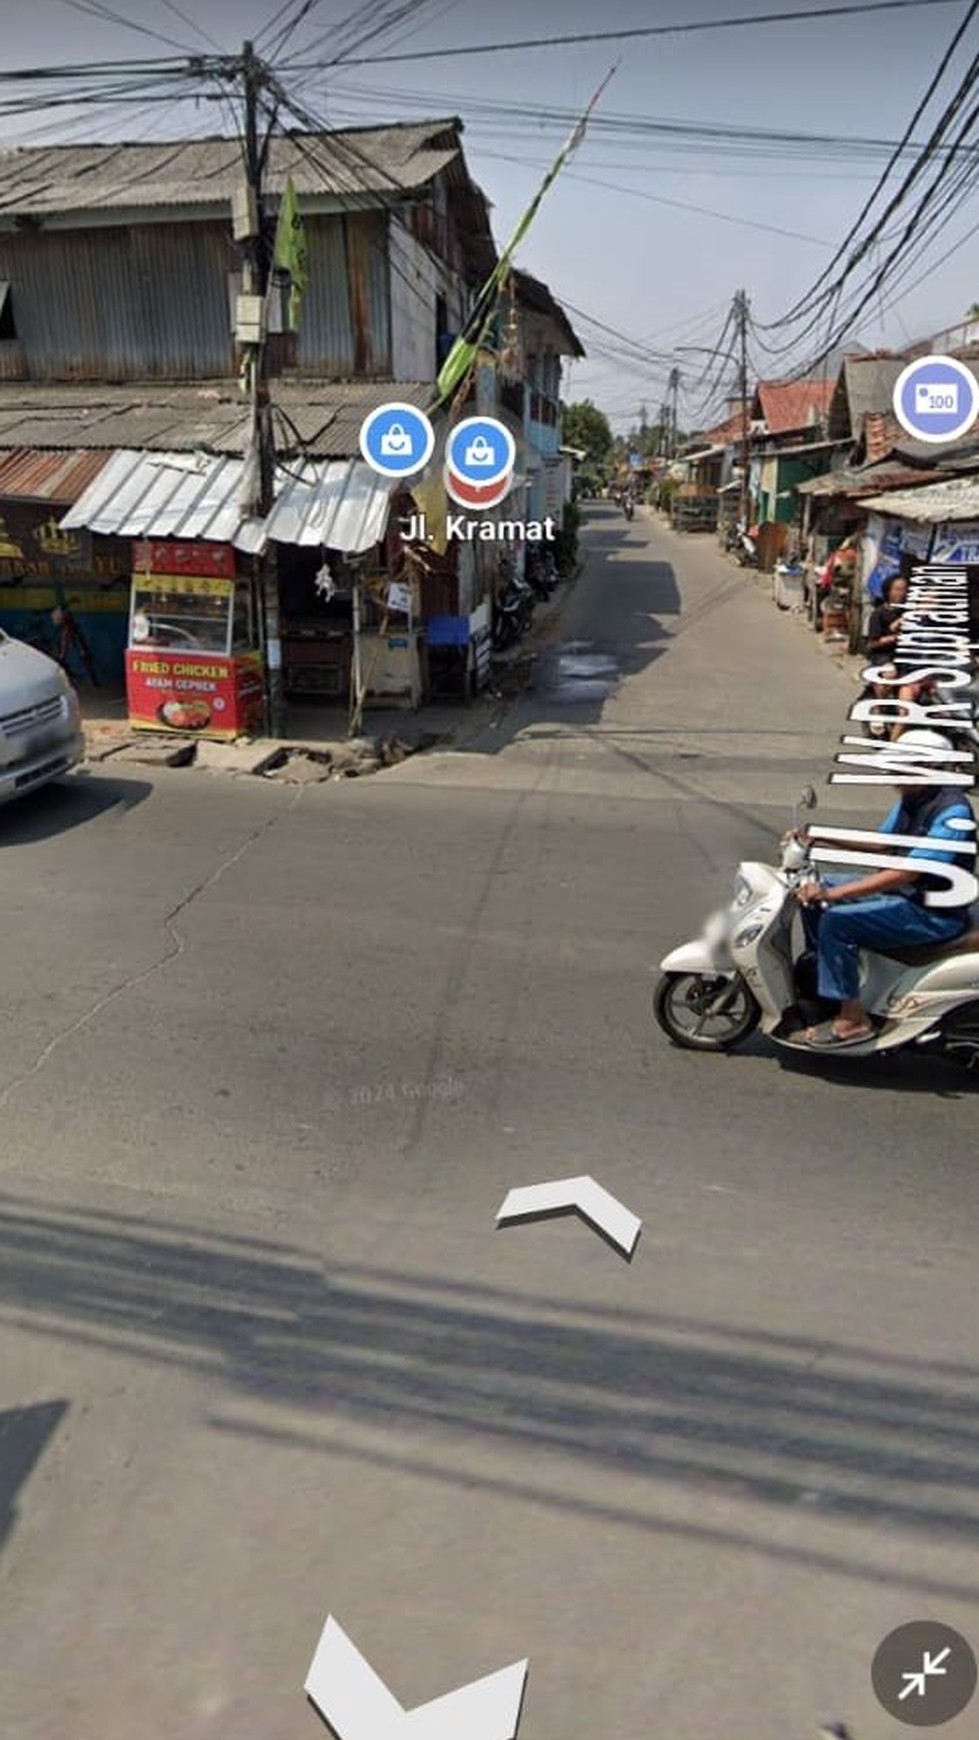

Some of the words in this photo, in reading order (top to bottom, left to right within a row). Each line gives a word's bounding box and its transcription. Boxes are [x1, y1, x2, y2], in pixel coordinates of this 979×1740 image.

[133, 660, 169, 675] FRIED
[173, 663, 228, 678] CHICKEN
[145, 677, 173, 690] AYAM
